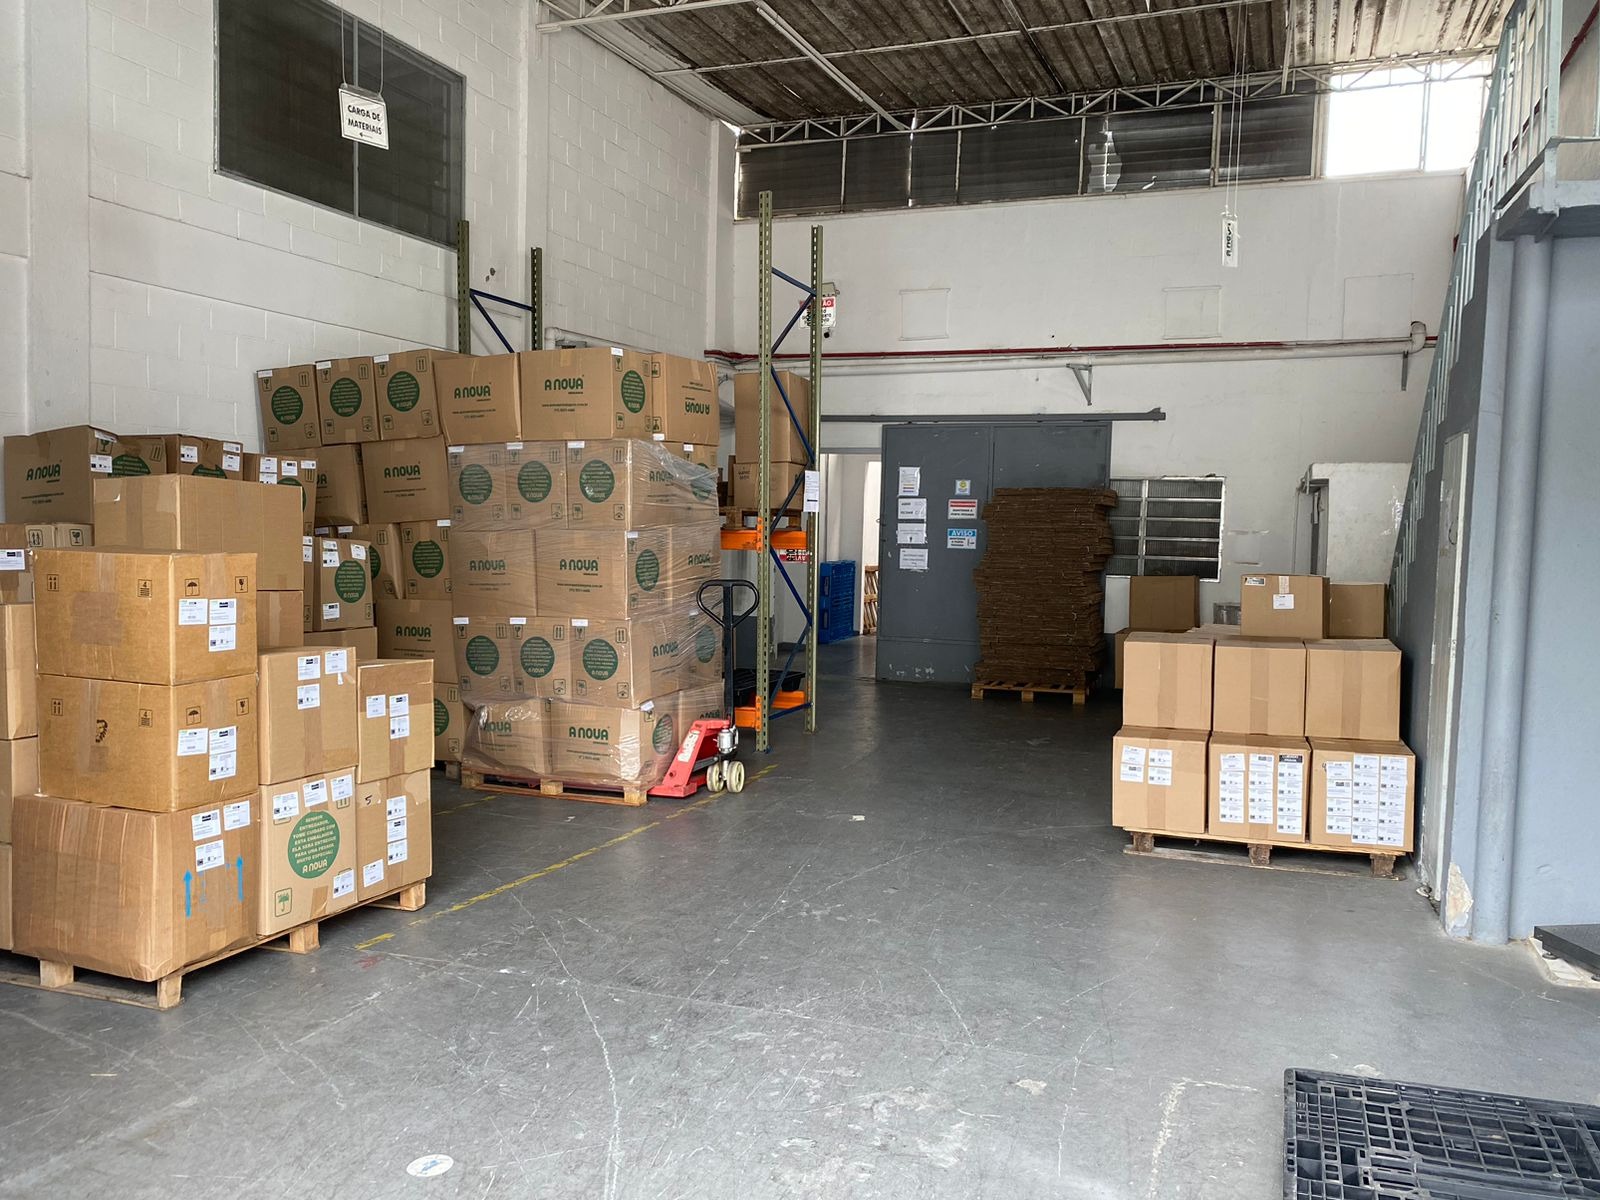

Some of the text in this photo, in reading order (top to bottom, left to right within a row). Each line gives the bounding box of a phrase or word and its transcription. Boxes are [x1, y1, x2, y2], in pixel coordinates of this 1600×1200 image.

[347, 104, 381, 122] CARGA DE
[348, 118, 383, 135] MATERIAIS
[544, 377, 584, 391] A NOVA
[454, 384, 491, 399] A NOVA
[685, 401, 710, 415] A NOVA
[26, 463, 61, 482] A NOVA
[383, 465, 421, 478] A NOVA
[469, 559, 506, 571] A NOVA
[559, 559, 599, 572] A NOVA
[395, 625, 431, 638] A NOVA
[569, 726, 609, 740] A NOVA
[305, 814, 323, 823] SENHOR
[293, 823, 336, 839] TOME CUIDADO COM
[294, 837, 307, 846] ESTA
[291, 845, 302, 853] ELA
[295, 850, 307, 858] PARA
[307, 847, 318, 855] UMA
[302, 859, 328, 874] A NOVA
